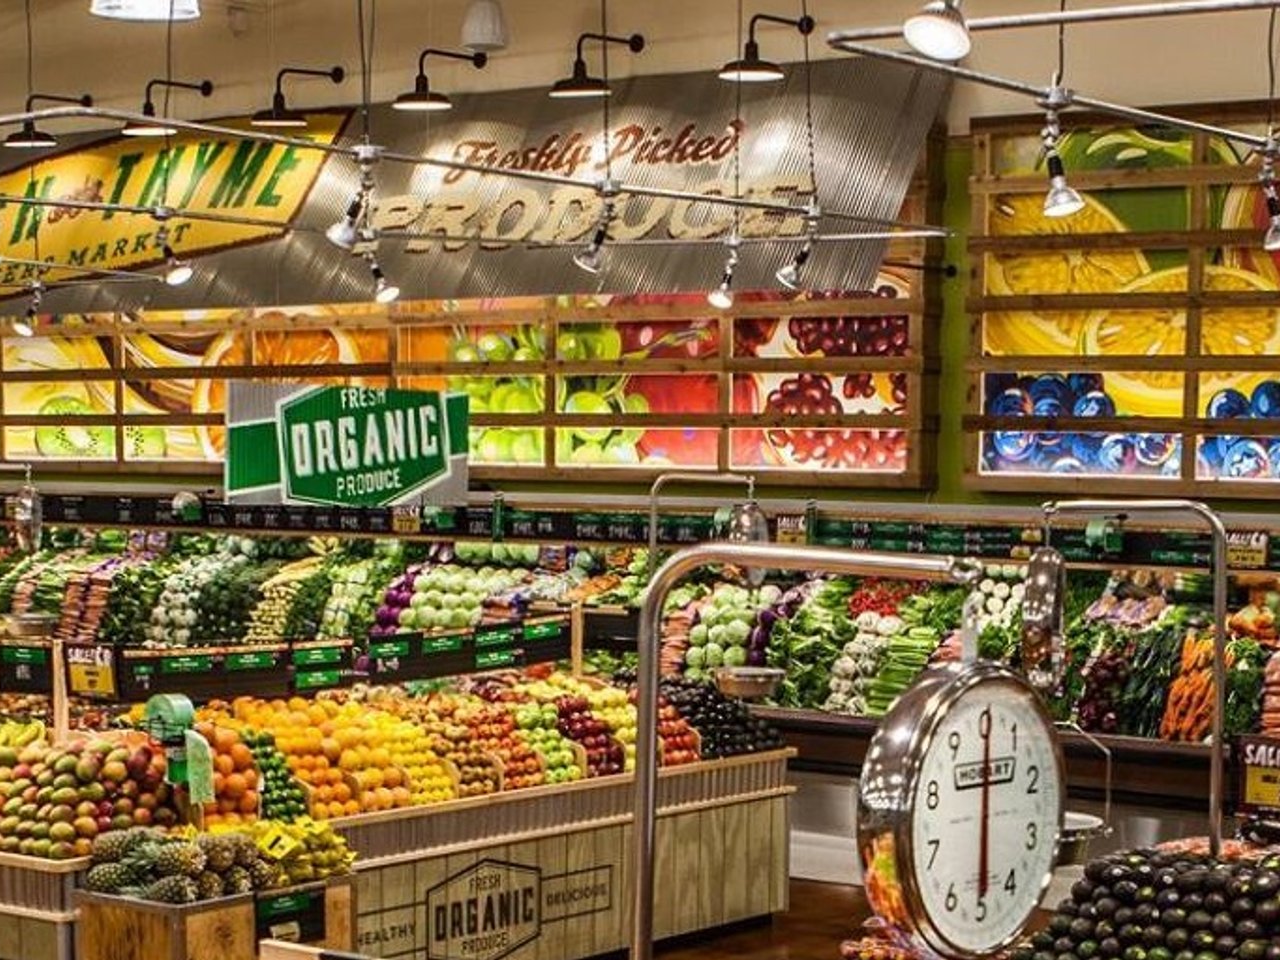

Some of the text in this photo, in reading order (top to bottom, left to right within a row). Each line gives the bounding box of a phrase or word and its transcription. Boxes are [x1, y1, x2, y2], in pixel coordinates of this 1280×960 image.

[443, 118, 744, 184] Freshly Picked
[104, 140, 301, 220] THYME
[351, 174, 816, 257] PRODUCE
[340, 387, 387, 410] FRESH
[290, 404, 439, 477] ORGANIC
[336, 468, 402, 498] PRODUCE
[949, 722, 1018, 760] 9 1
[926, 765, 1039, 810] 8 2
[926, 822, 1038, 871] 7 3
[469, 874, 502, 891] FRESH
[944, 868, 1017, 912] 6 4
[435, 887, 534, 942] ORGANIC
[546, 883, 608, 907] DELICIOUS
[975, 897, 987, 923] 5
[461, 931, 509, 955] PRODUCE
